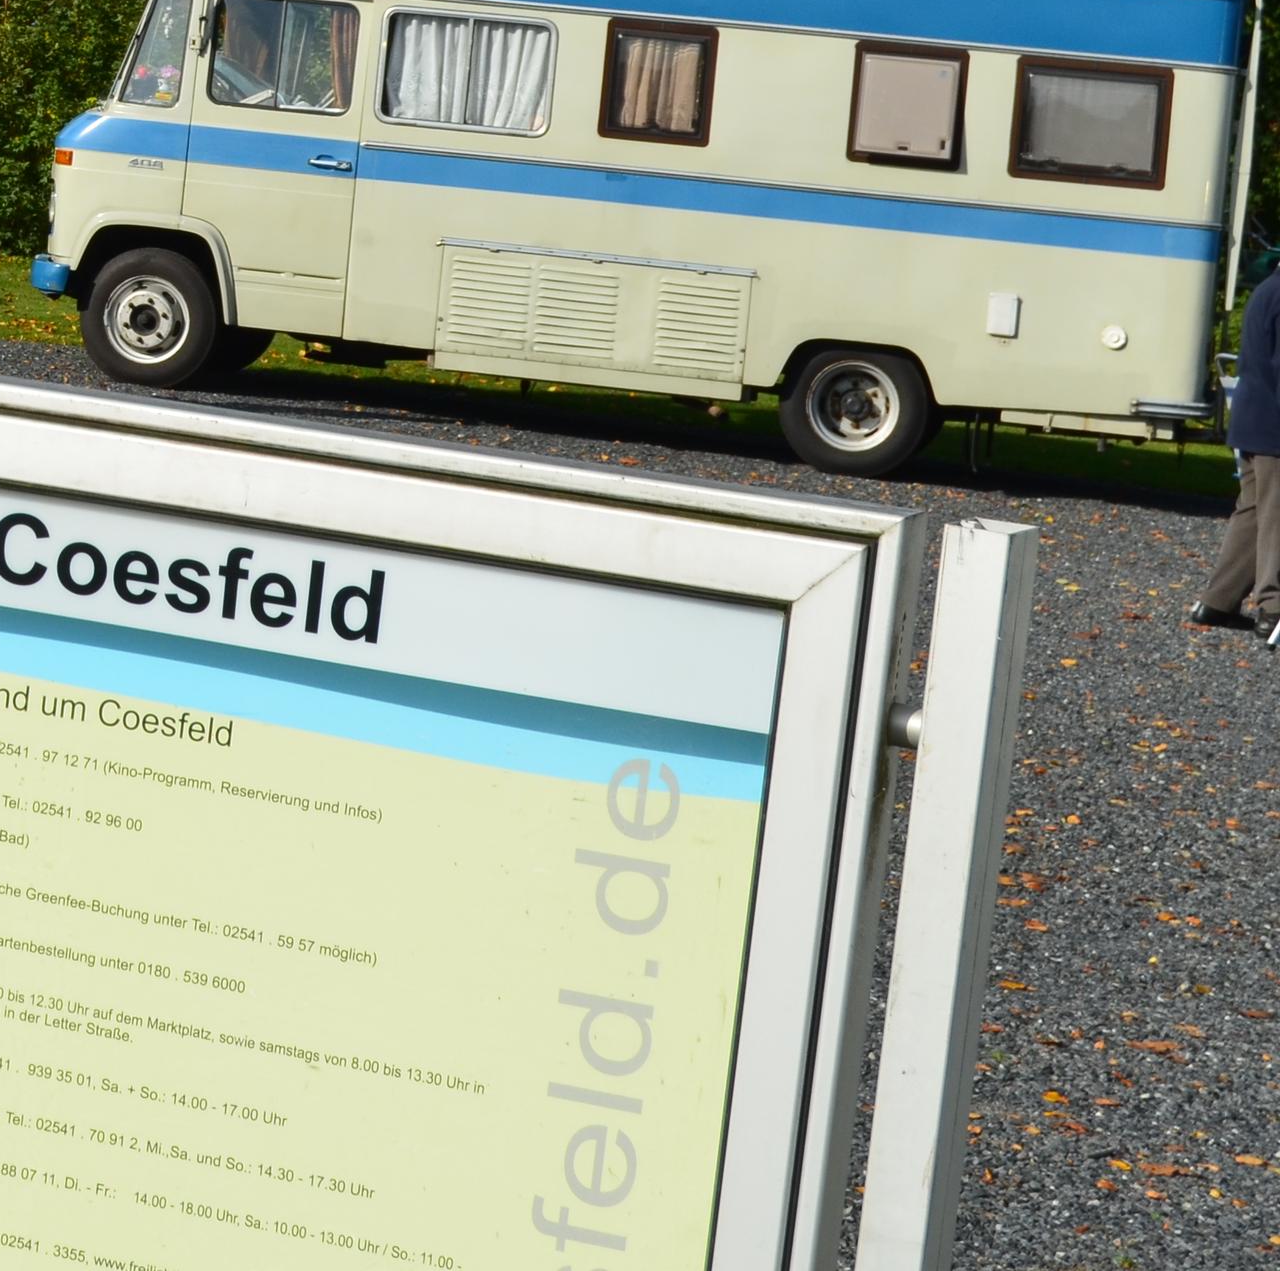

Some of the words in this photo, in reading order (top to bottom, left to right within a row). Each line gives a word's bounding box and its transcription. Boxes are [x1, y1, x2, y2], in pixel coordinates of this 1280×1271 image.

[40, 694, 87, 723] um
[97, 697, 234, 749] Coesfeld
[1, 793, 29, 812] Tel.:
[31, 799, 72, 820] 02541
[84, 808, 102, 825] 92
[104, 812, 123, 829] 96
[124, 816, 144, 833] 00
[41, 748, 60, 764] 97
[62, 752, 80, 769] 12
[82, 755, 99, 772] 71
[102, 759, 216, 794] (Kino-Programm,
[219, 779, 311, 813] Reservierung
[313, 799, 341, 815] und
[343, 801, 383, 825] Infos)
[24, 886, 150, 926] Greenfee-Buchung
[152, 912, 189, 930] unter
[190, 917, 219, 936] Tel.:
[221, 923, 264, 944] 02541
[276, 933, 295, 950] 59
[297, 937, 316, 953] 57
[318, 943, 378, 968] möglich)
[99, 955, 135, 973] unter
[136, 960, 172, 980] 0180
[181, 969, 209, 987] 539
[210, 974, 247, 995] 6000
[2, 1004, 16, 1020] in
[17, 1008, 42, 1025] der
[43, 1012, 83, 1033] Letter
[84, 1020, 134, 1044] Straße.
[531, 757, 682, 1271] feld.de
[26, 1062, 53, 1080] 939
[54, 1067, 73, 1084] 35
[75, 1072, 97, 1091] 01,
[99, 1077, 123, 1095] Sa.
[138, 1084, 167, 1103] So.:
[170, 1091, 209, 1112] 14.00
[221, 1102, 260, 1122] 17.00
[261, 1109, 288, 1127] Uhr
[0, 1232, 40, 1253] 02541
[51, 1243, 90, 1266] 3355,
